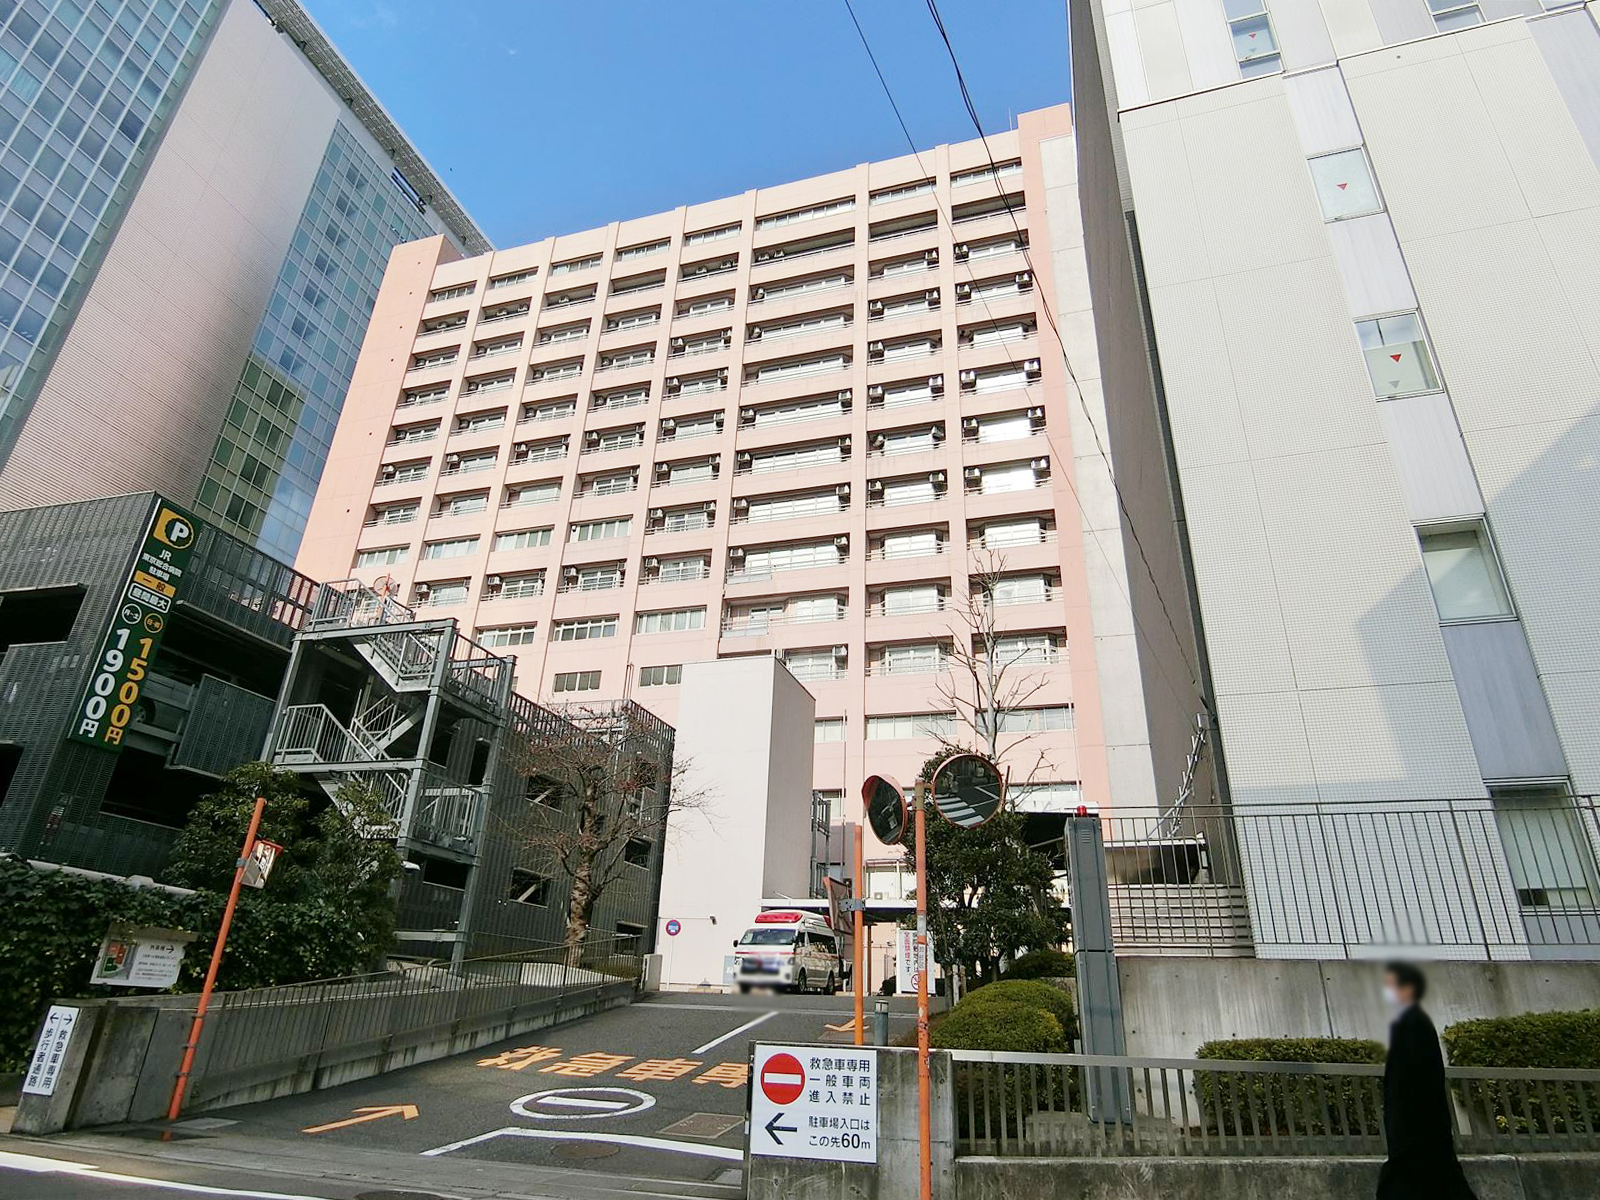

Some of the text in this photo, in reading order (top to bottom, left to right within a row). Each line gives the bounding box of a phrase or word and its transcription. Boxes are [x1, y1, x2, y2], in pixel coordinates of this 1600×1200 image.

[170, 521, 189, 542] P
[158, 549, 172, 562] JR
[143, 577, 166, 592] 一般
[80, 628, 130, 738] 1900円
[104, 638, 153, 745] 1500円
[28, 1027, 54, 1087] 歩行者通路
[42, 1029, 68, 1089] 救急車専用
[809, 1057, 870, 1073] 救急車専用
[809, 1074, 871, 1090] 一般車両
[809, 1090, 871, 1106] 進入禁止
[808, 1116, 870, 1130] 駐車場入口は
[809, 1133, 871, 1149] この先60m
